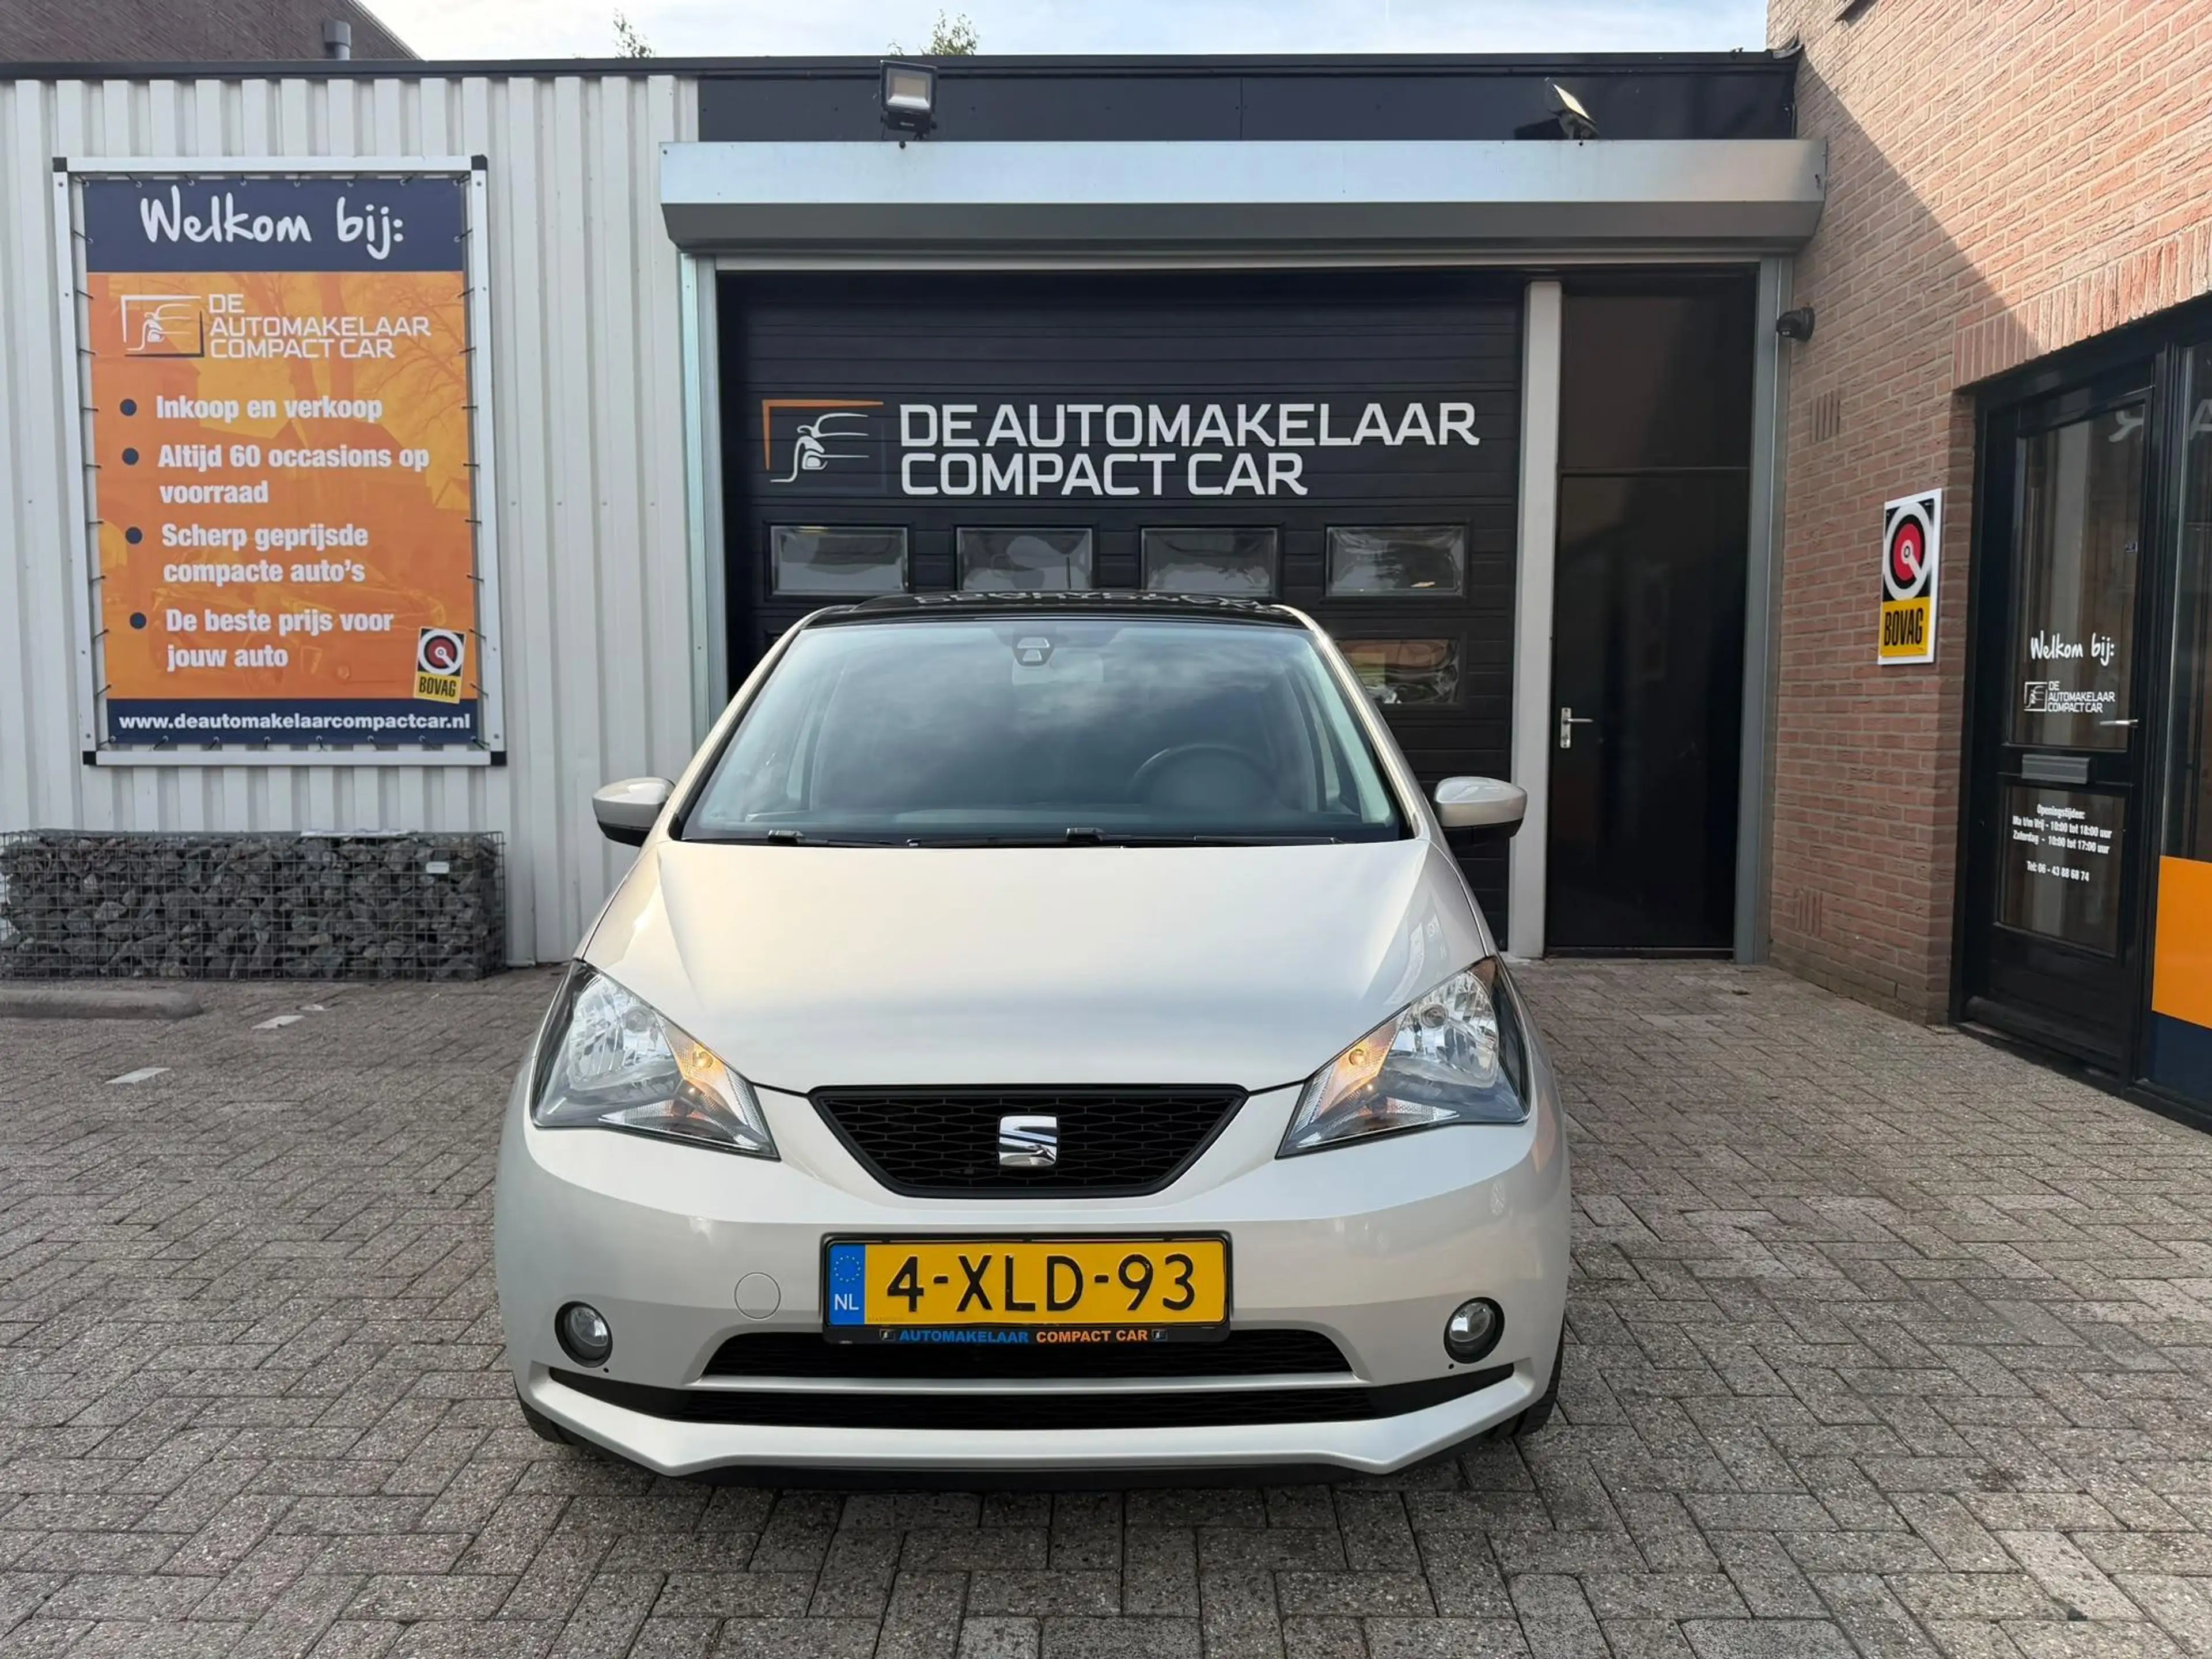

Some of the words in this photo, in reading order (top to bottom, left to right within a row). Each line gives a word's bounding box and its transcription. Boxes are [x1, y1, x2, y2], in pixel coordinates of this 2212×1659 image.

[140, 185, 312, 243] Welkom
[336, 196, 403, 260] bij:
[209, 294, 244, 314] DE
[210, 316, 431, 337] AUTOMAKELAAR
[210, 338, 335, 358] COMPACT
[340, 338, 395, 358] CAR
[157, 395, 240, 423] Inkoop
[247, 400, 276, 418] en
[284, 395, 382, 423] verkoop
[158, 445, 222, 472] Altijd
[230, 445, 261, 467] 60
[268, 445, 392, 467] occasions
[399, 449, 429, 472] op
[902, 453, 1176, 495] COMPACT
[1188, 453, 1308, 495] CAR
[159, 480, 268, 504] voorraad
[162, 523, 248, 551] Scherp
[255, 523, 368, 552] geprijsde
[164, 559, 283, 587] compacte
[290, 559, 365, 582] auto's
[166, 609, 197, 631] De
[204, 609, 271, 632] beste
[279, 609, 333, 637] prijs
[339, 613, 394, 631] voor
[1884, 608, 1923, 646] BOVAG
[167, 645, 227, 672] jouw
[234, 645, 289, 667] auto
[2031, 631, 2083, 658] Welkom
[2092, 633, 2114, 666] bij:
[419, 676, 457, 698] BOVAG
[2048, 692, 2115, 702] AUTOMAKELAAR
[2049, 681, 2059, 690] DE
[2048, 702, 2084, 712] COMPACT
[2085, 703, 2103, 713] CAR
[119, 713, 470, 732] www.deautomakelaarcompactcar.nl
[2037, 804, 2085, 819] Openingstijden:
[2050, 821, 2068, 833] 10:00
[2069, 823, 2078, 834] tot
[2080, 825, 2098, 837] 18:00
[2100, 830, 2112, 839] uur
[2013, 830, 2039, 845] Zaterdag
[2048, 835, 2066, 847] 10:00
[2067, 838, 2076, 849] tot
[2078, 840, 2096, 852] 17:00
[2097, 844, 2110, 854] uur
[2051, 866, 2060, 876] 43
[2080, 870, 2090, 882] 74
[887, 1253, 1195, 1312] 4-XLD-93
[835, 1294, 859, 1310] NL
[899, 1330, 1028, 1343] AUTOMAKELAAR
[1036, 1330, 1111, 1343] COMPACT
[1116, 1330, 1148, 1342] CAR
